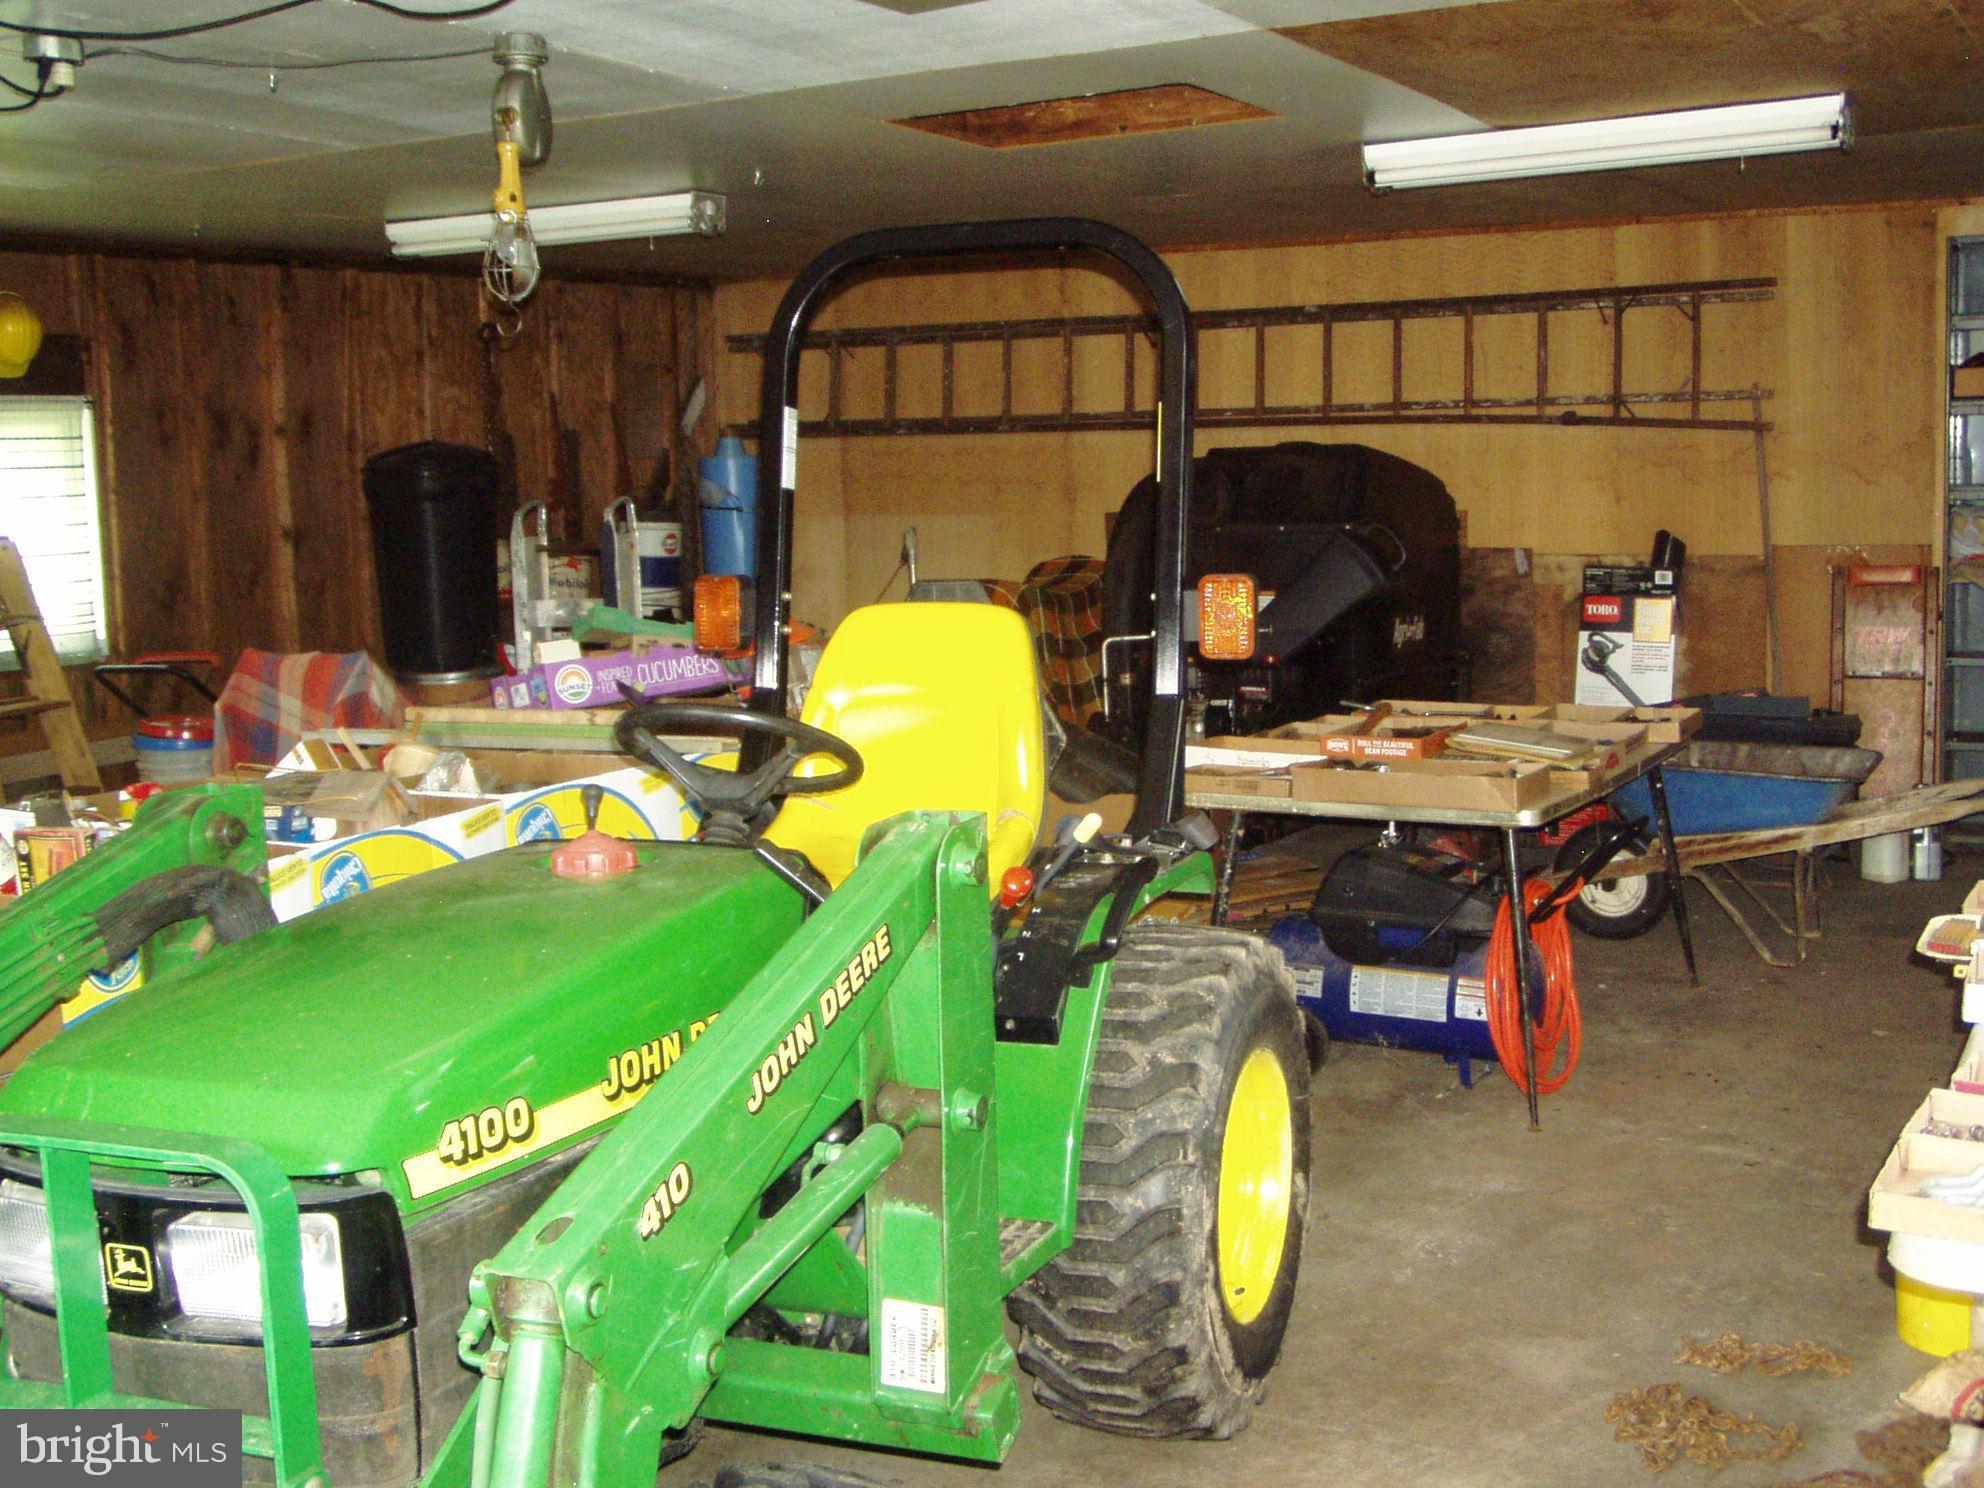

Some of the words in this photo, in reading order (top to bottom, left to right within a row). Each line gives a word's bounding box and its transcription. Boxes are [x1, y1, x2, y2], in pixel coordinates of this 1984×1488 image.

[1586, 604, 1619, 615] TORO
[559, 682, 592, 695] SUNSET
[637, 654, 719, 686] CUCUMBERS
[1365, 747, 1380, 755] BEAN
[1382, 748, 1408, 757] FOOTAGE
[1383, 740, 1415, 750] BEAUTIFUL
[321, 857, 362, 900] Chiquita
[747, 1011, 817, 1115] JOHN
[819, 923, 892, 1029] DEERE
[600, 1030, 684, 1102] JOHN
[439, 1096, 534, 1166] 4100
[639, 1161, 693, 1242] 410
